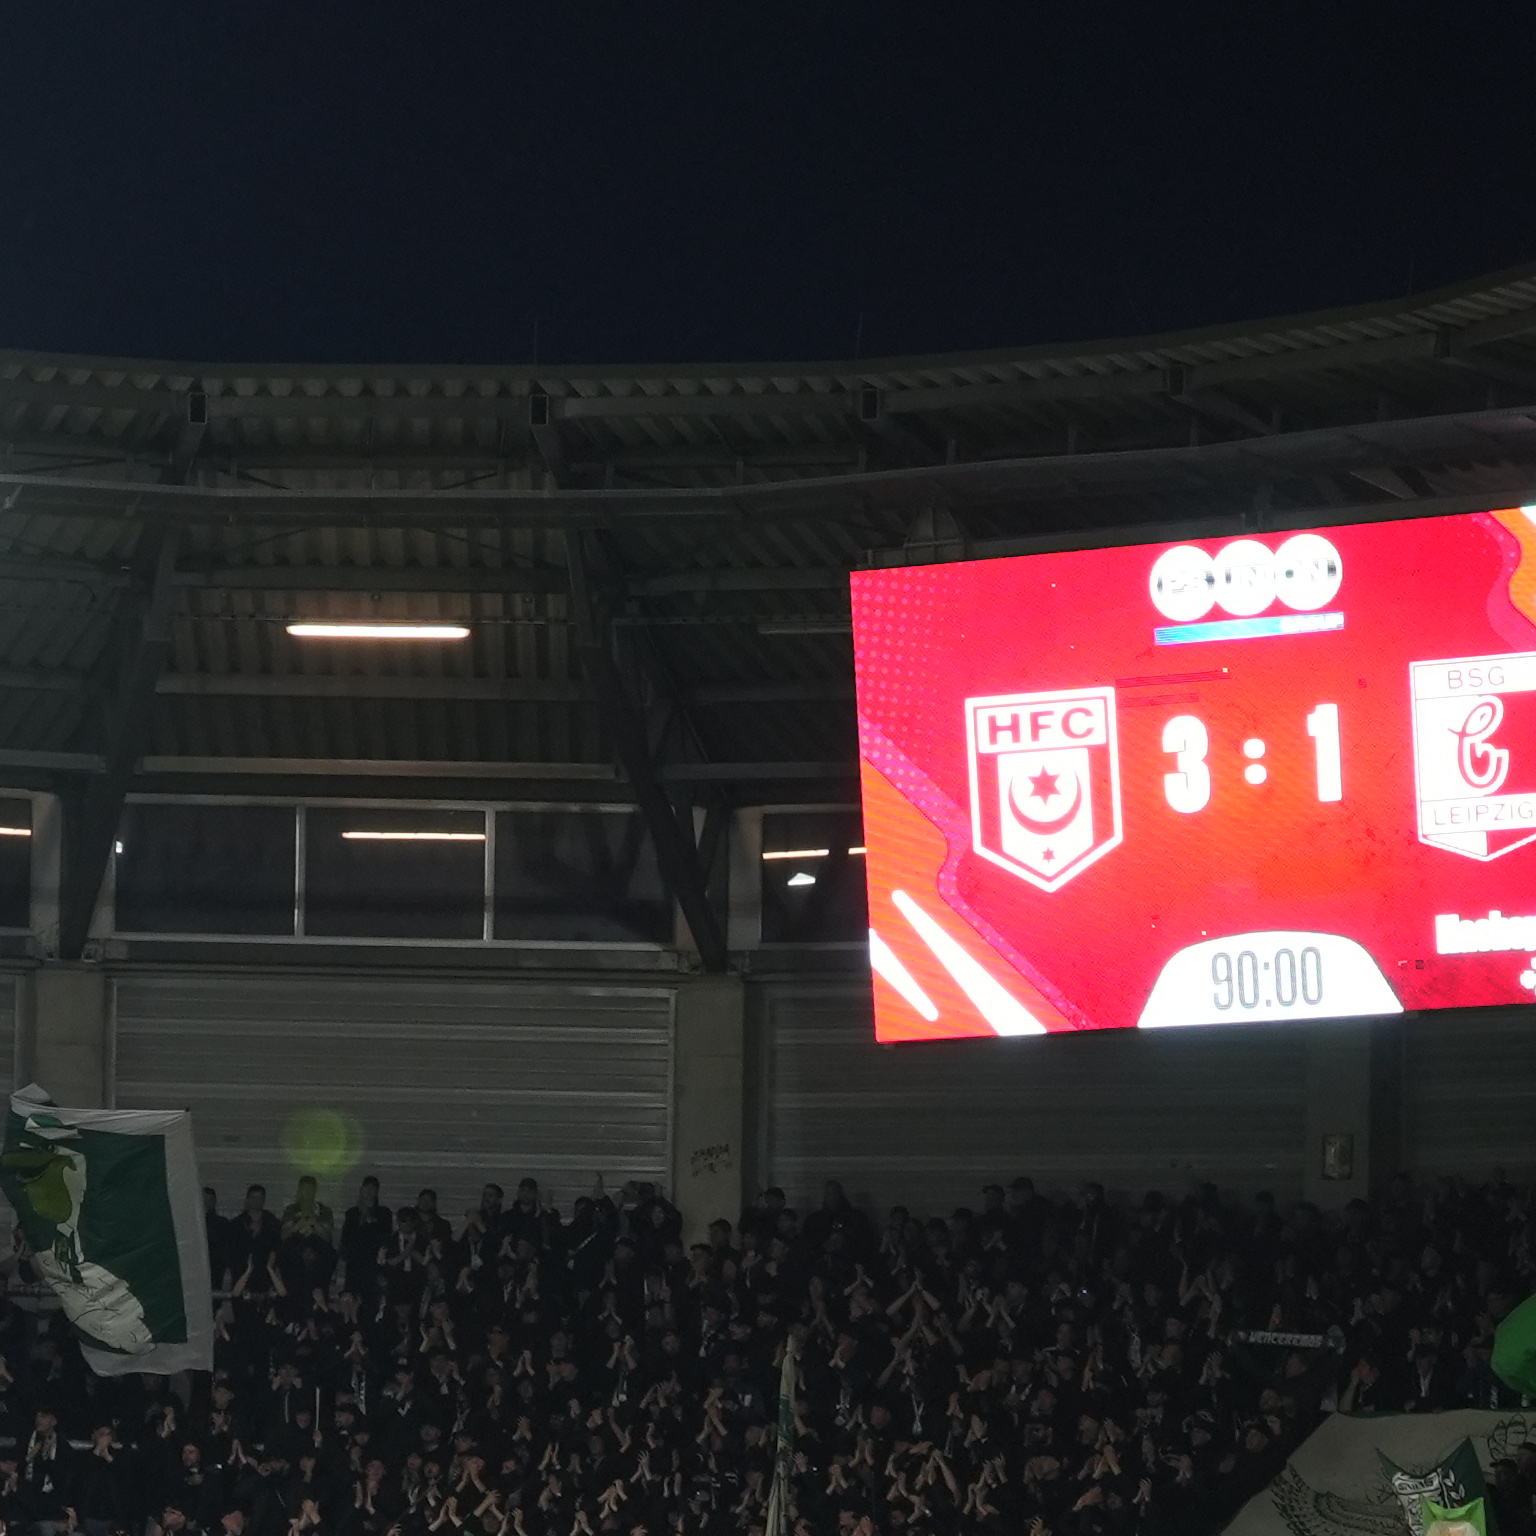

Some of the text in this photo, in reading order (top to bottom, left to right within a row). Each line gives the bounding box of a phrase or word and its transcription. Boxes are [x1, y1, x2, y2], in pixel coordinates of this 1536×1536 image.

[1448, 667, 1505, 689] BSG
[987, 707, 1095, 745] HFC
[1162, 715, 1211, 814] 3
[1306, 703, 1343, 802] 1
[1433, 802, 1534, 825] LEIPZIG
[1211, 946, 1324, 1011] 90:00
